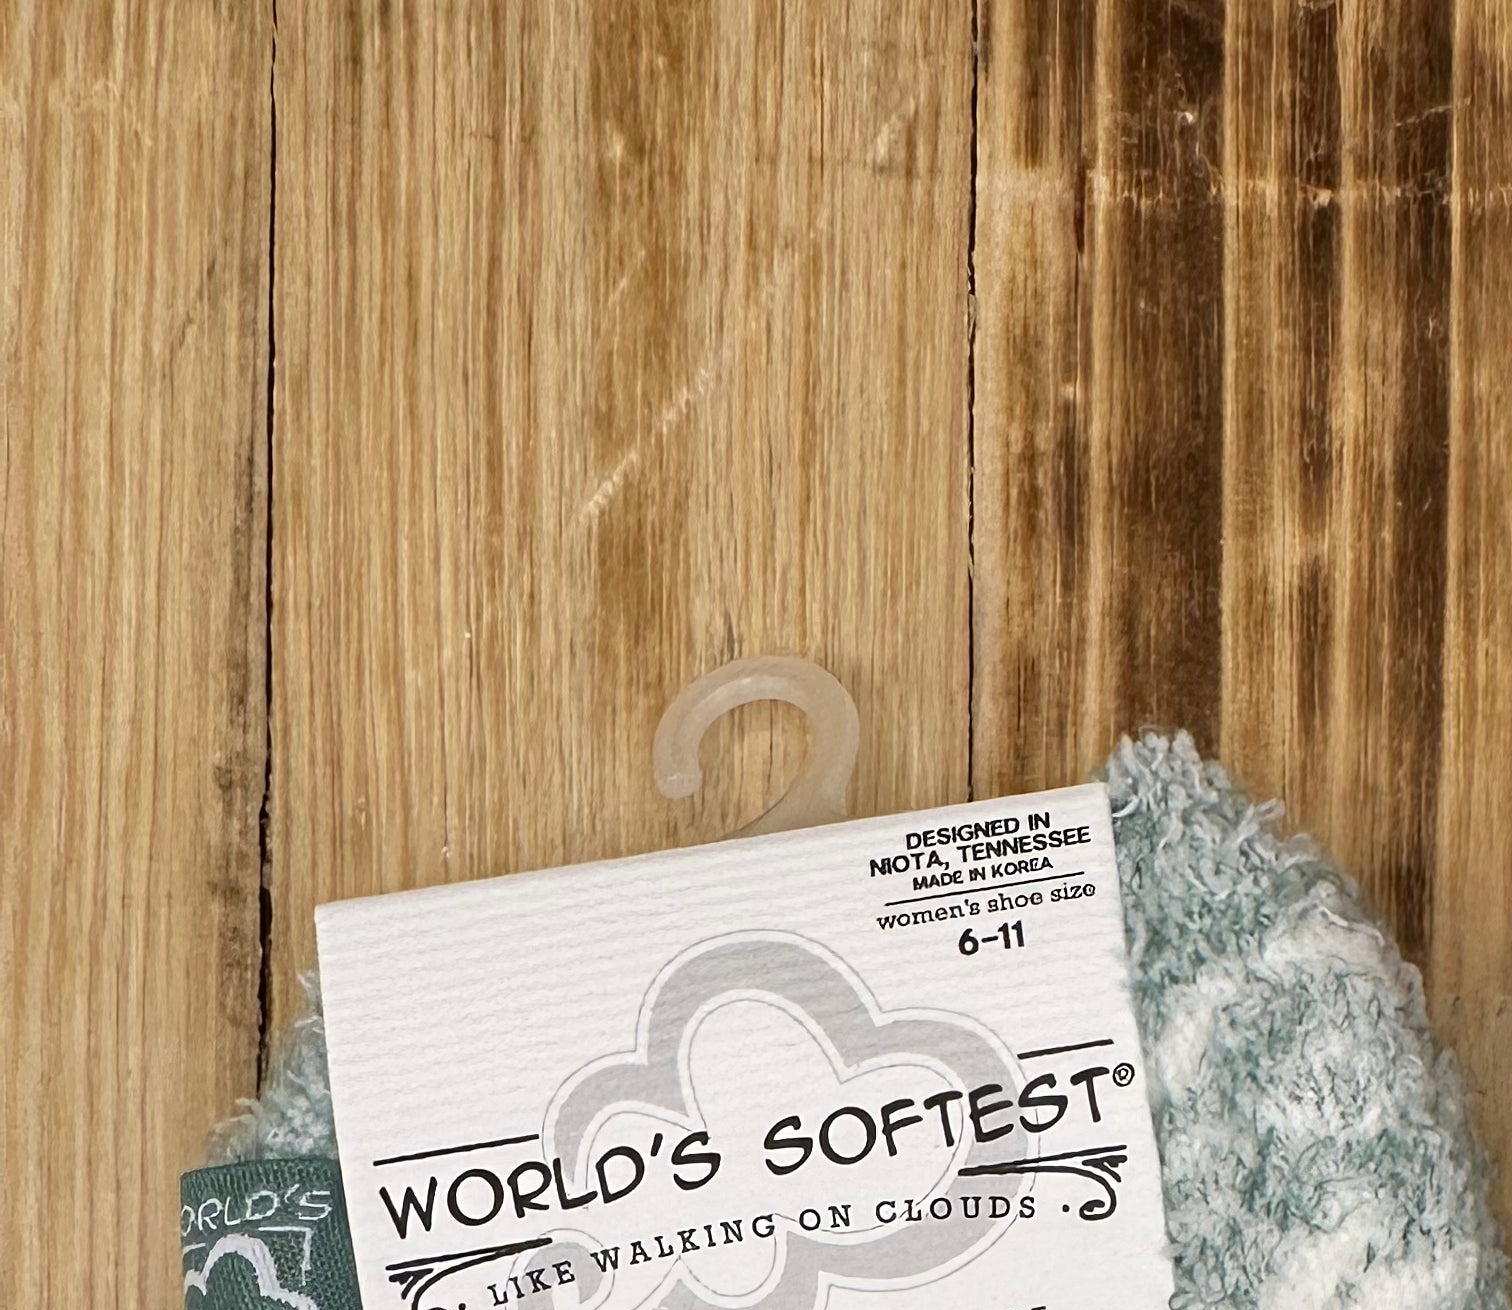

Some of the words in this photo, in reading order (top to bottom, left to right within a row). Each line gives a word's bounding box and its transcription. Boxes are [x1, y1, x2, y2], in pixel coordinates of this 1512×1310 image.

[869, 849, 950, 877] NIOTA,
[956, 826, 1092, 864] TENNESSEE
[906, 817, 1020, 850] DESIGNED
[1028, 811, 1051, 831] IN
[912, 870, 964, 891] MADE
[969, 867, 986, 882] IN
[991, 856, 1054, 879] KOREA
[876, 898, 981, 931] women's
[987, 892, 1043, 914] shoe
[1050, 881, 1096, 902] size
[958, 920, 1026, 956] 6-11
[378, 1130, 722, 1240] WORLD'S
[486, 1260, 577, 1306] LIKE
[590, 1213, 776, 1273] WALKING
[798, 1204, 853, 1230] ON
[874, 1196, 1036, 1224] CLOUDS
